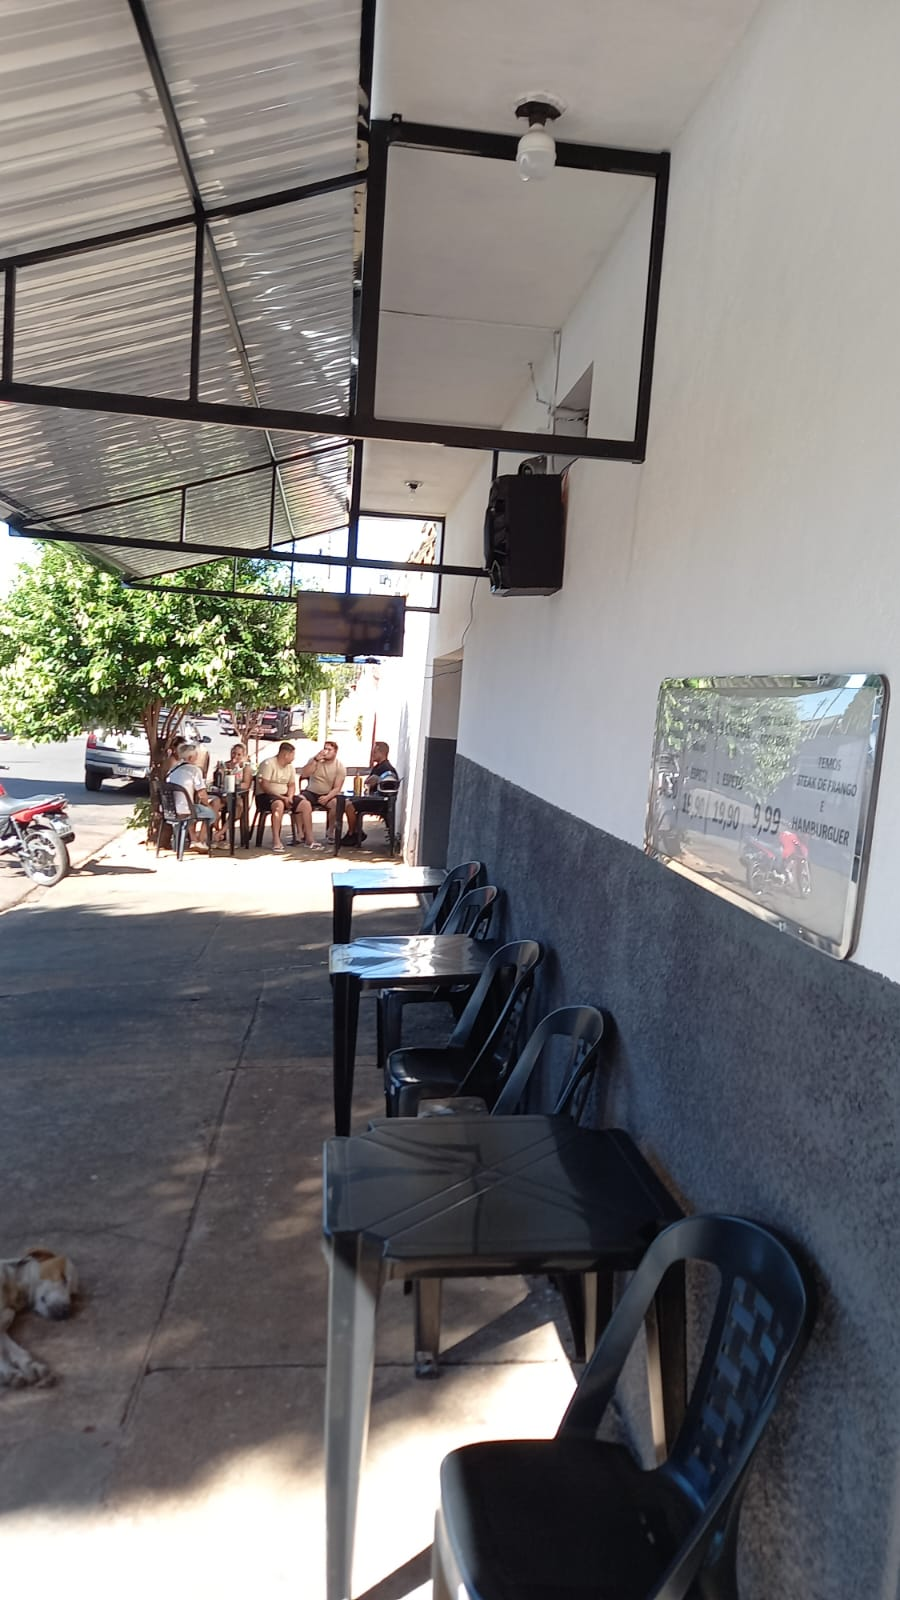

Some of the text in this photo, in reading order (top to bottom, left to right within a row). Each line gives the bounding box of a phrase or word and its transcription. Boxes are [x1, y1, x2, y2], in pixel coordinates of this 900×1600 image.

[818, 756, 842, 771] TEMOS
[796, 774, 858, 797] STEAK DE FRANGO
[711, 801, 741, 831] 19,90
[752, 803, 782, 835] 9,99
[819, 800, 825, 813] E
[791, 815, 850, 846] HAMBURGUER
